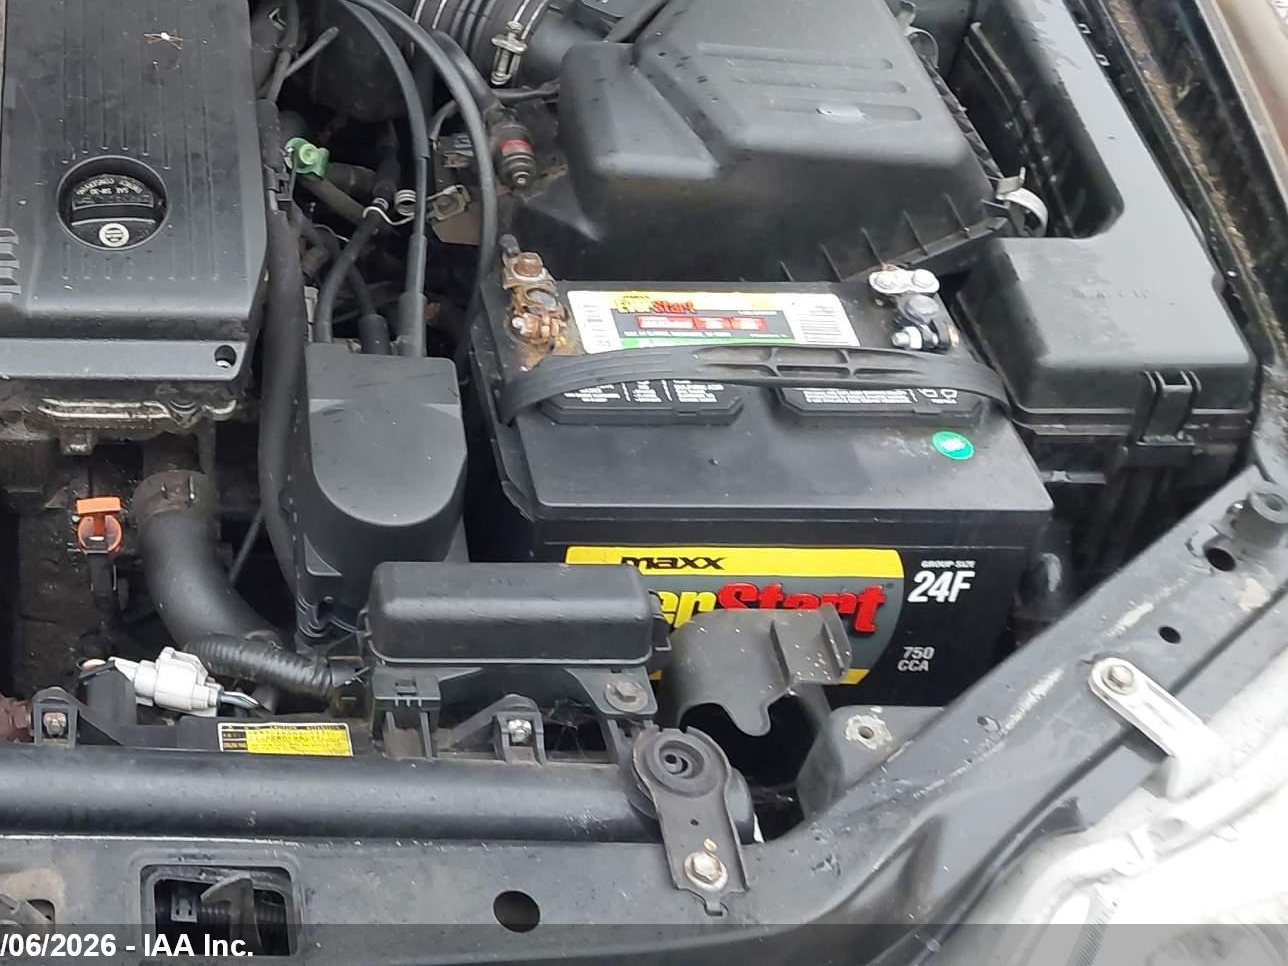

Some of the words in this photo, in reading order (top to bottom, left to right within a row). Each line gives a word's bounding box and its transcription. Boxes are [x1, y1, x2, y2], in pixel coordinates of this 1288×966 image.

[621, 556, 726, 570] maxx
[907, 570, 976, 603] 24F
[903, 646, 935, 660] 750
[897, 659, 929, 672] CCA
